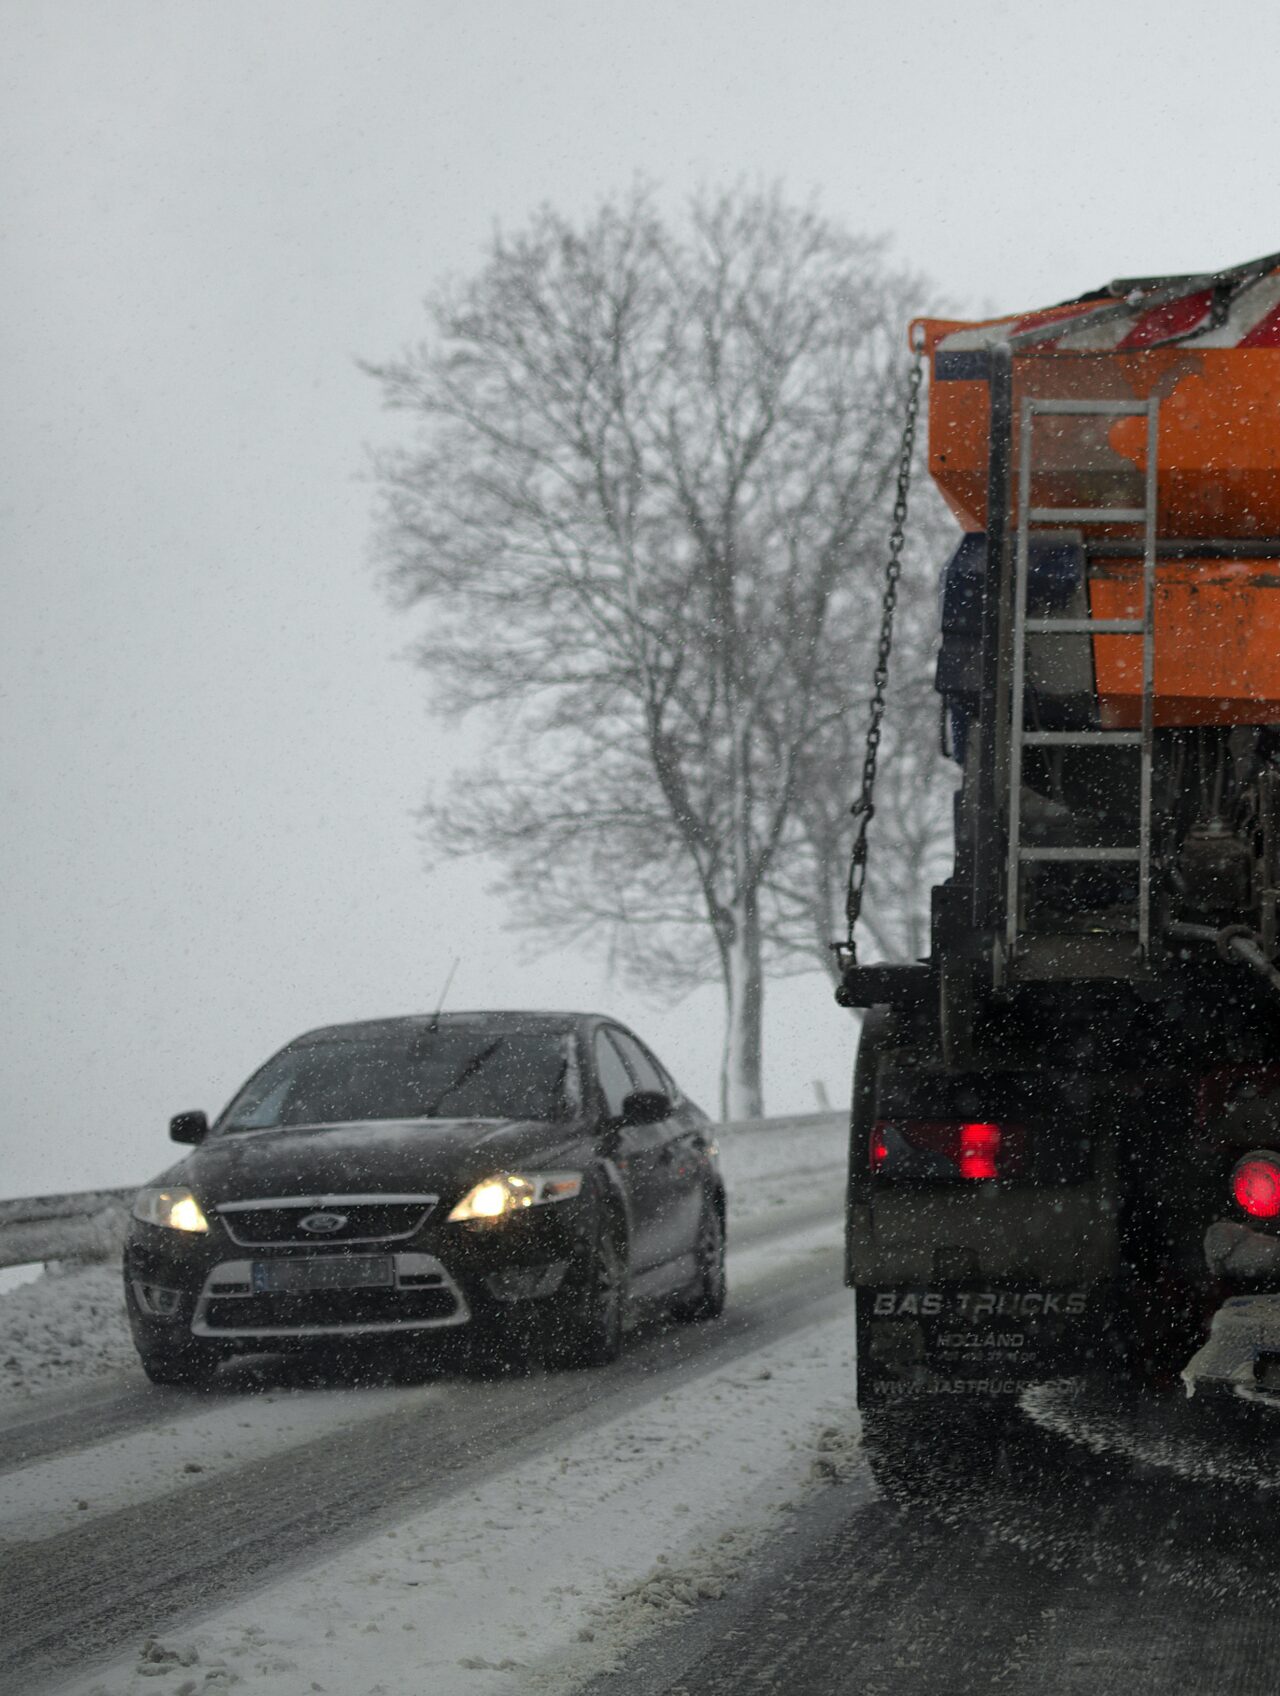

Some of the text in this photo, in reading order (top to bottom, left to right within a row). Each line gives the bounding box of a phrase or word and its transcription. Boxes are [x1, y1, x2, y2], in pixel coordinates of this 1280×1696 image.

[873, 1293, 1088, 1315] BAS TRUCKS
[873, 1380, 1088, 1394] WWW.ASTRUCKCOM
